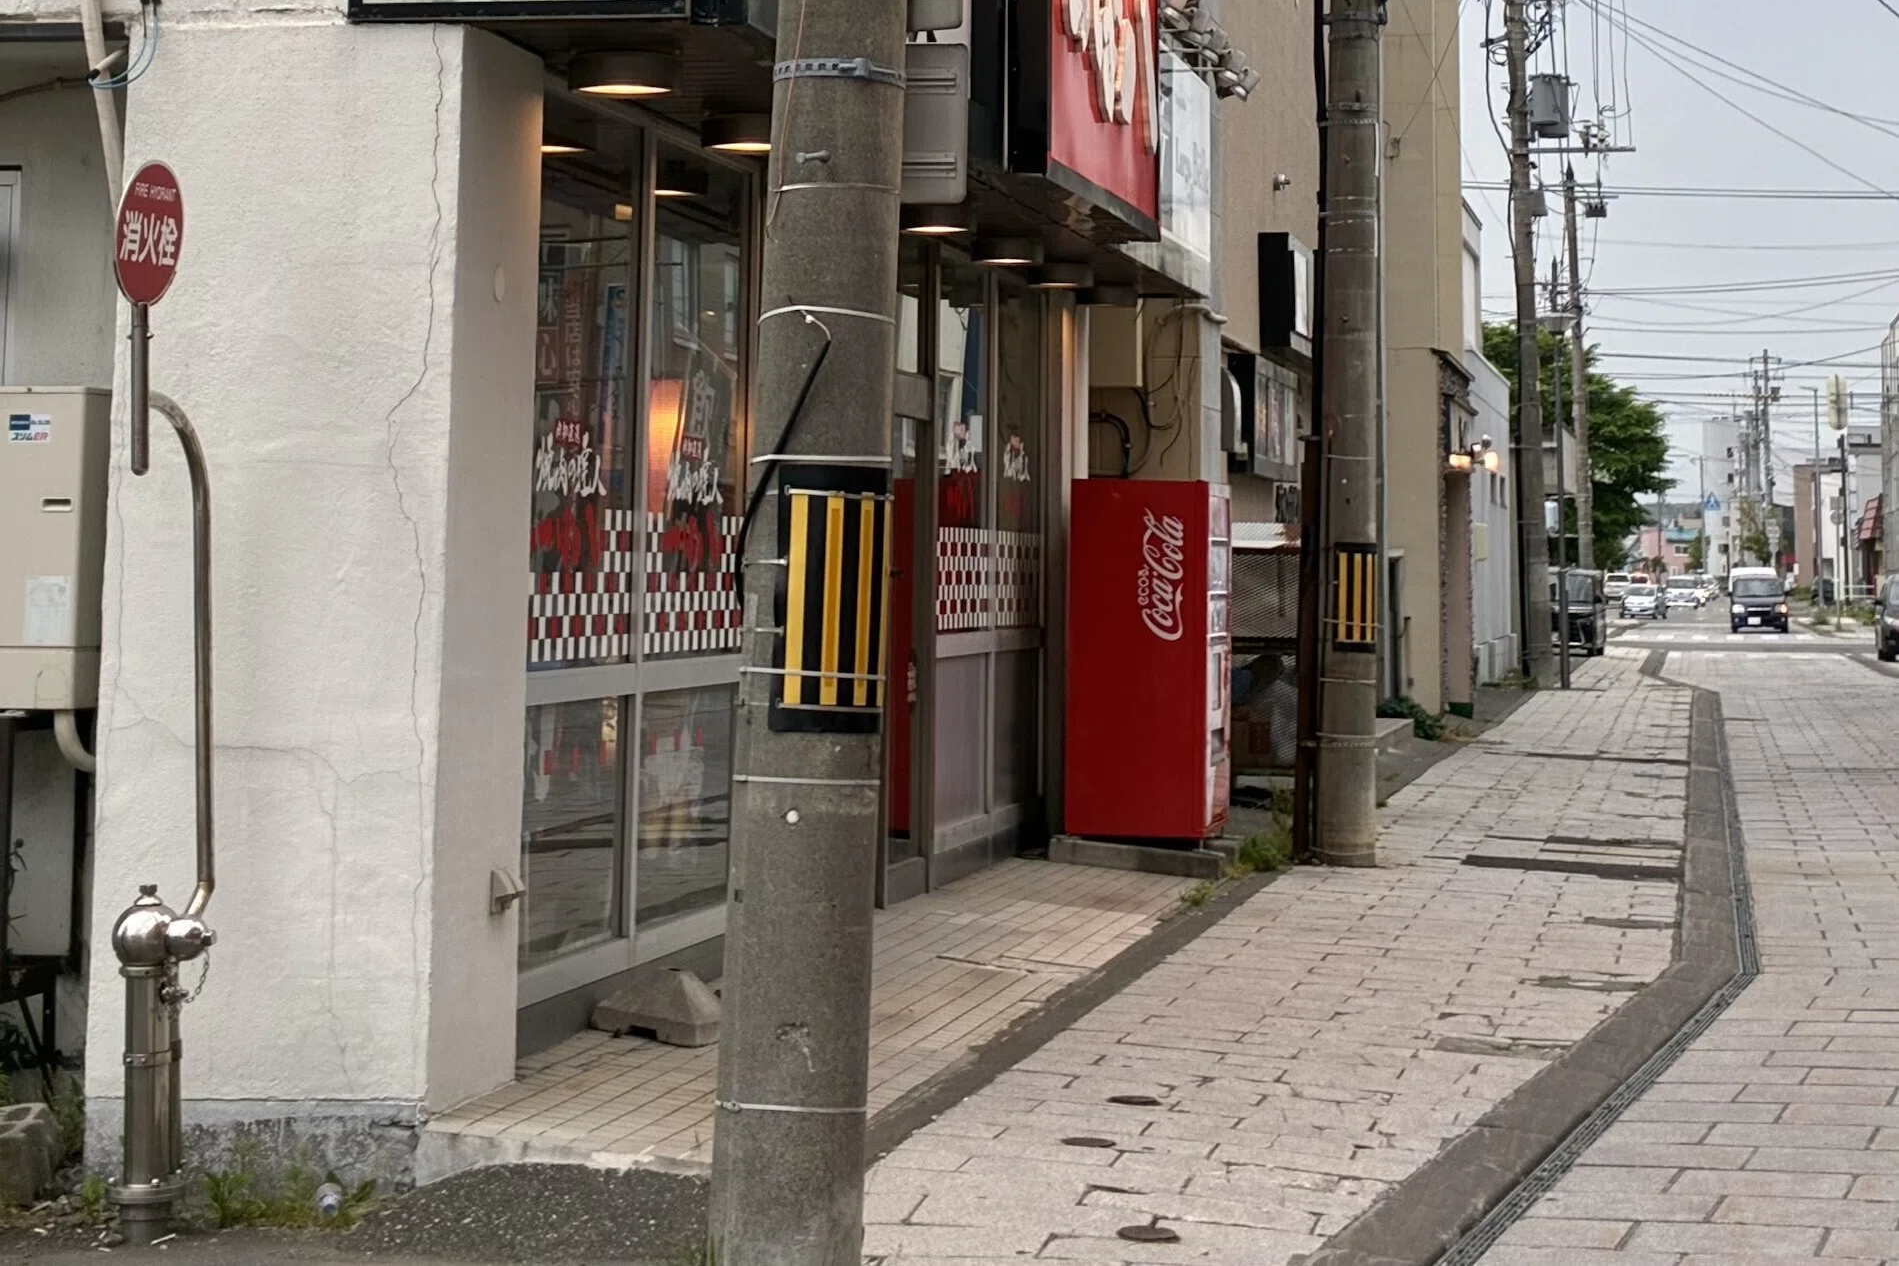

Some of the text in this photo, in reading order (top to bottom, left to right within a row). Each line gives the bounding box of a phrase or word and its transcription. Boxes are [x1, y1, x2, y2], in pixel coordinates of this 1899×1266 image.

[134, 182, 177, 202] FIRE HYDRANT
[120, 209, 178, 266] 消火栓
[1142, 508, 1184, 641] Coca-Cola
